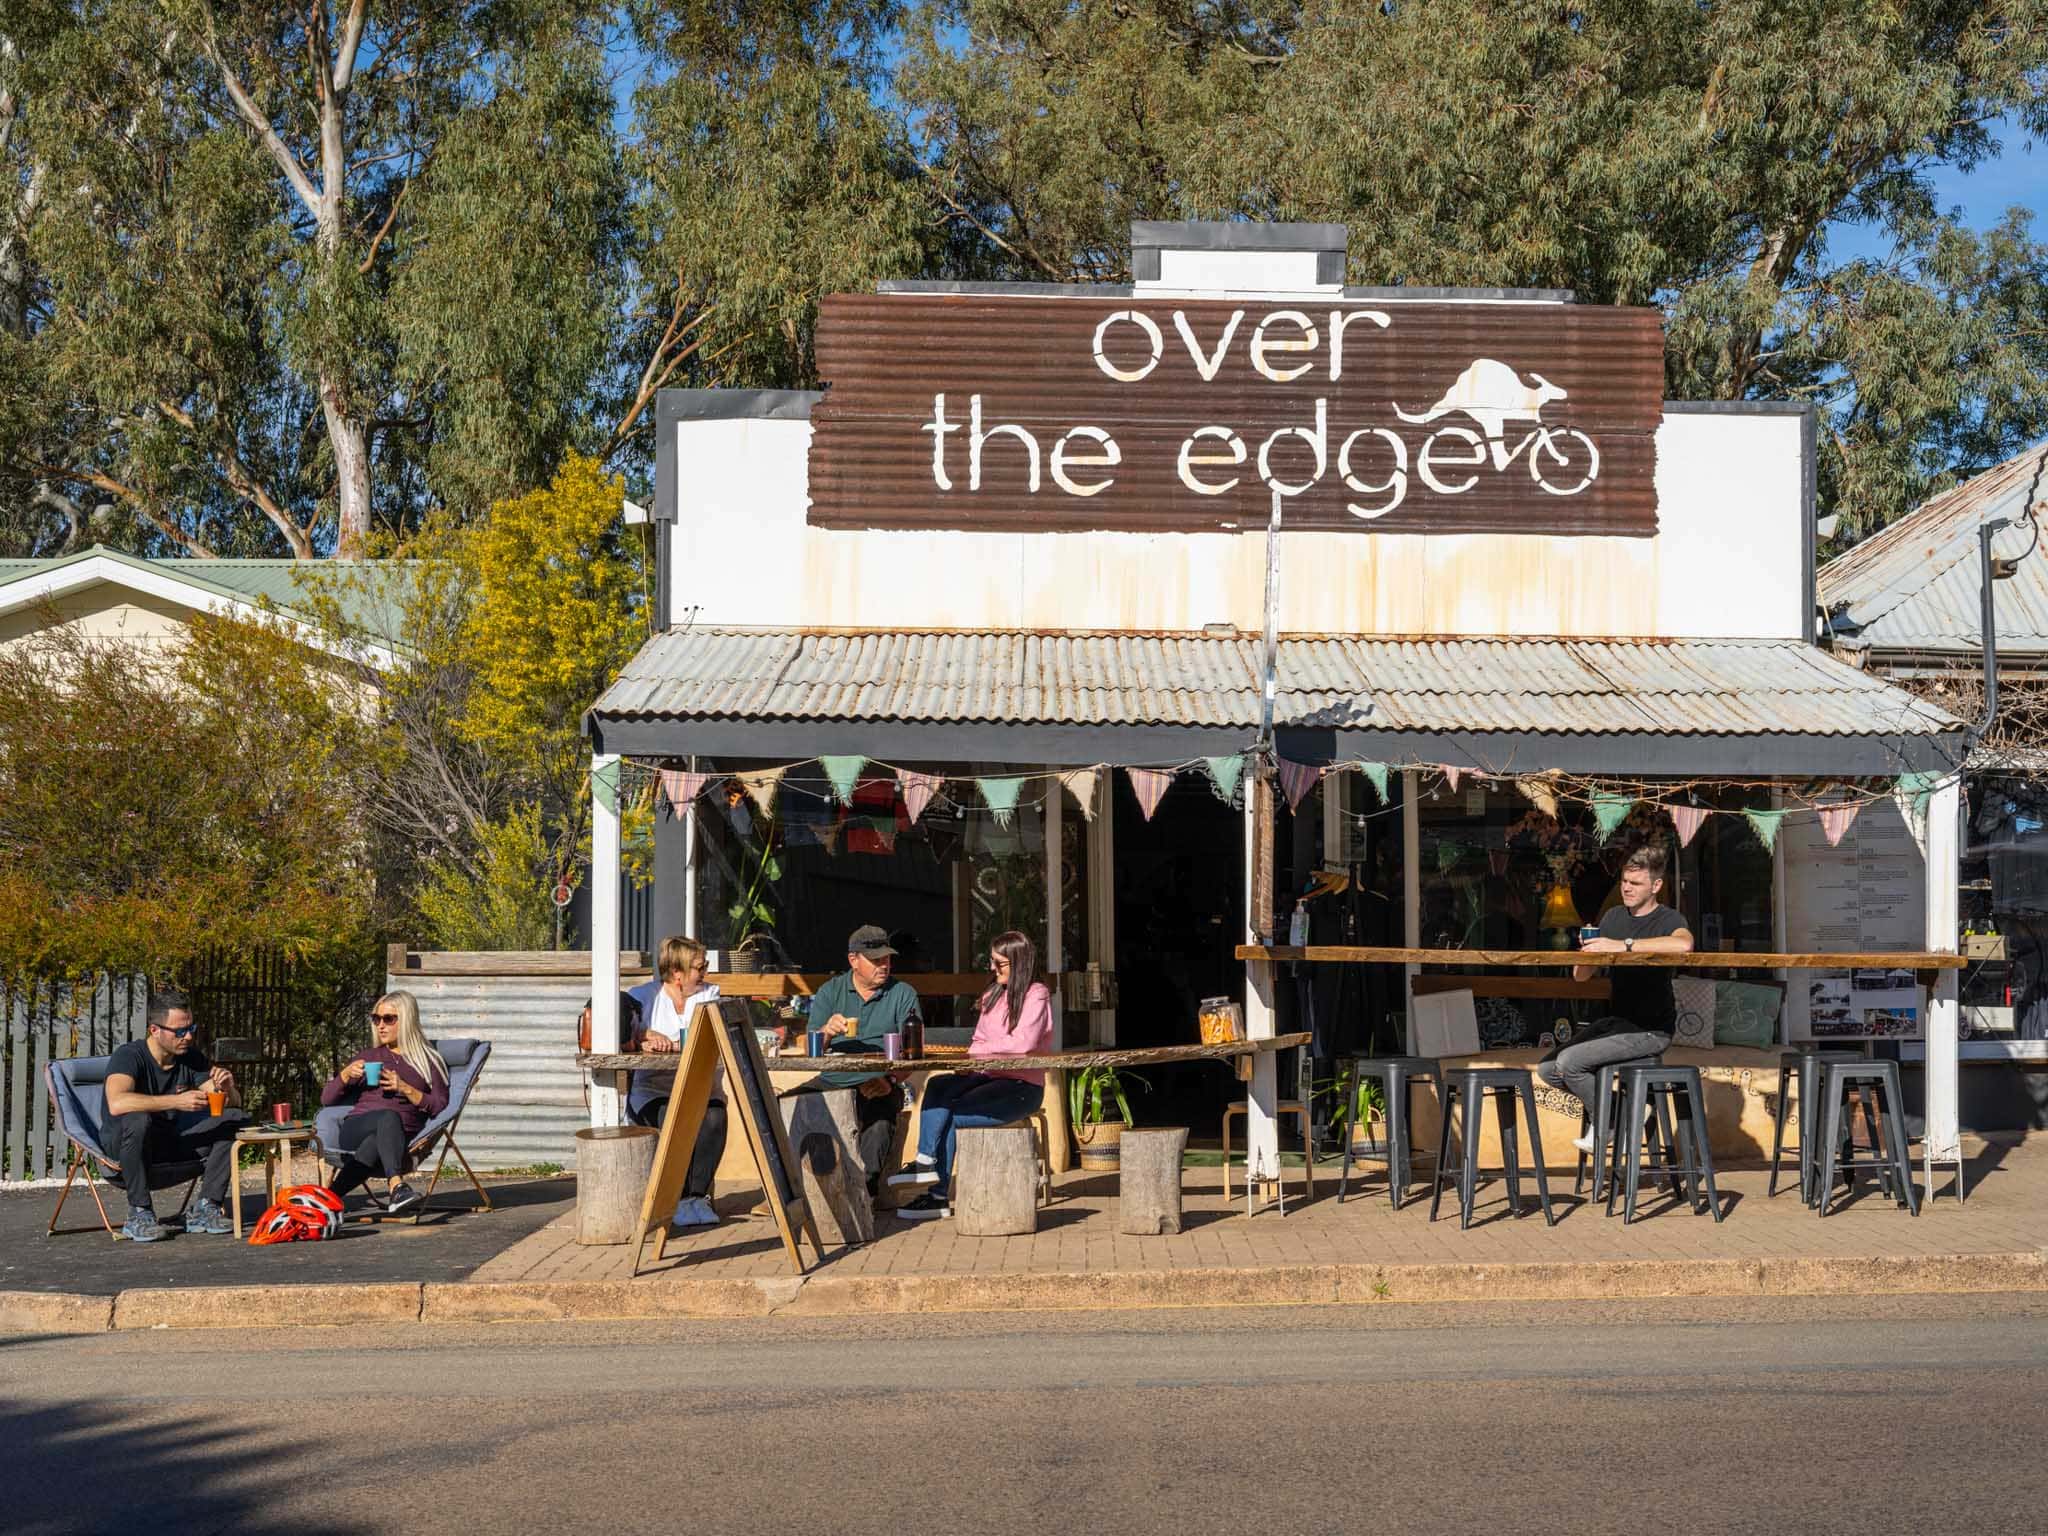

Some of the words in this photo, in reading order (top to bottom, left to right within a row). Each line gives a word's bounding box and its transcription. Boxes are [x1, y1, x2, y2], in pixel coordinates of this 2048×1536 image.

[1092, 309, 1392, 382] over
[921, 393, 1122, 497] the
[1176, 397, 1488, 520] edge
